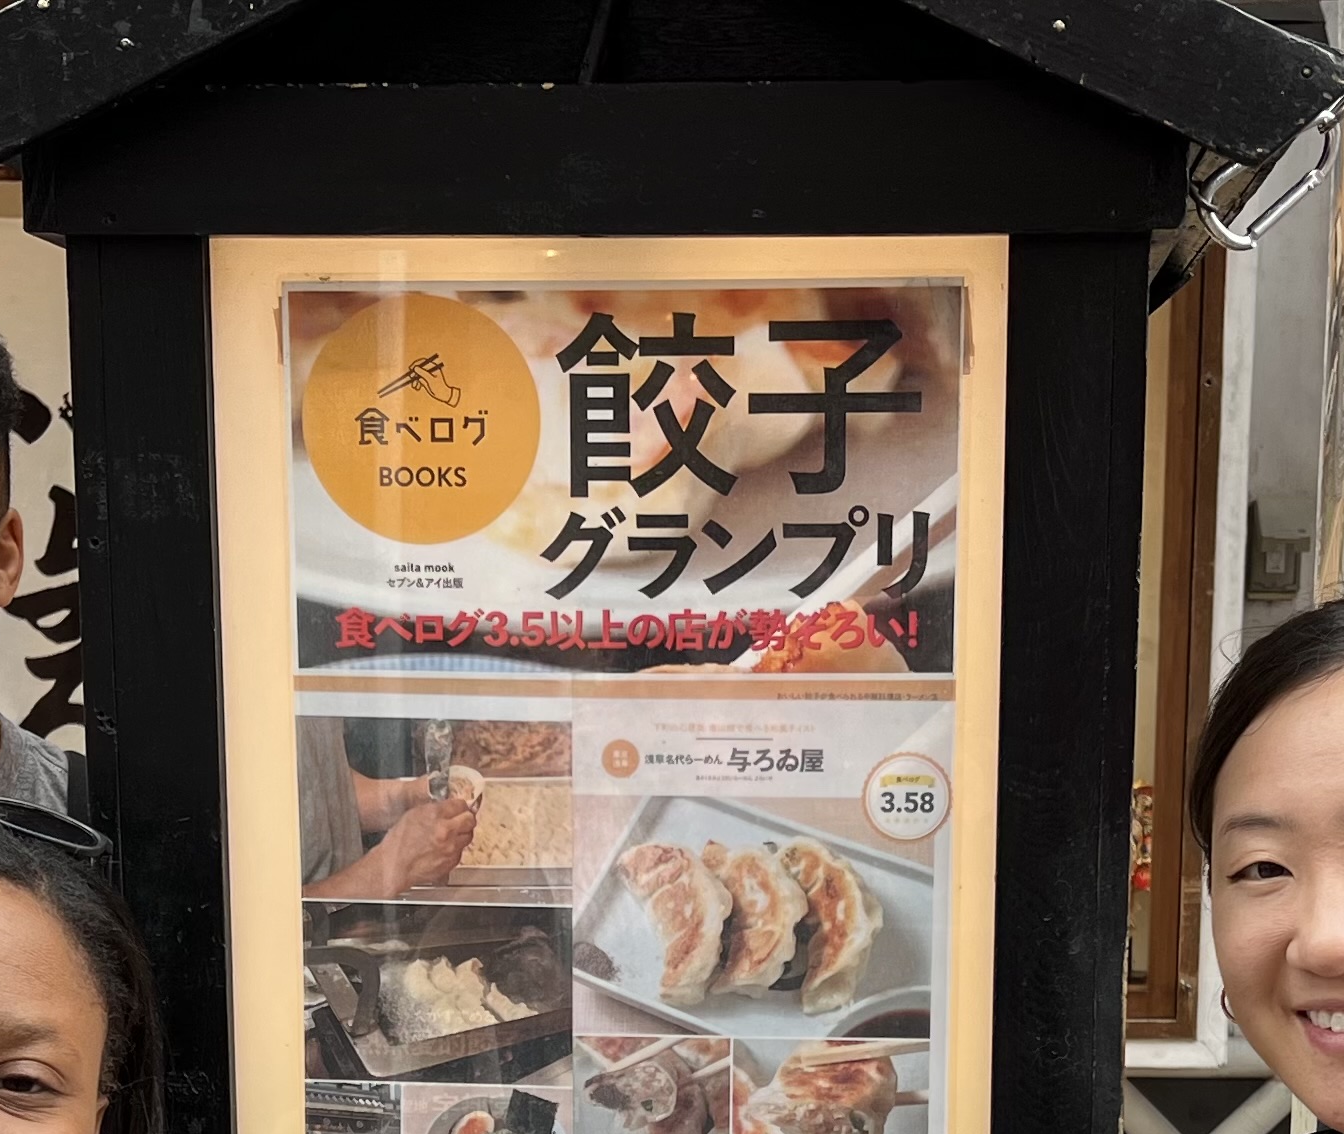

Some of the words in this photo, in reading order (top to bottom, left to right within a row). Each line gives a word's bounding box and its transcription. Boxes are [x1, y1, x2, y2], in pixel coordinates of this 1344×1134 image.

[555, 311, 923, 498] 餃子
[354, 407, 489, 448] 食べログ
[378, 465, 468, 489] BOOKS
[540, 504, 932, 601] グランプリ
[394, 562, 421, 573] saita
[424, 562, 456, 573] mook
[386, 577, 464, 589] セブン&アイ出版
[334, 606, 920, 652] 食べログ3.5以上の店が勢ぞろい!
[644, 754, 723, 766] 浅草名代らーめん
[727, 747, 825, 773] 与ろゐ屋
[880, 791, 936, 815] 3.58
